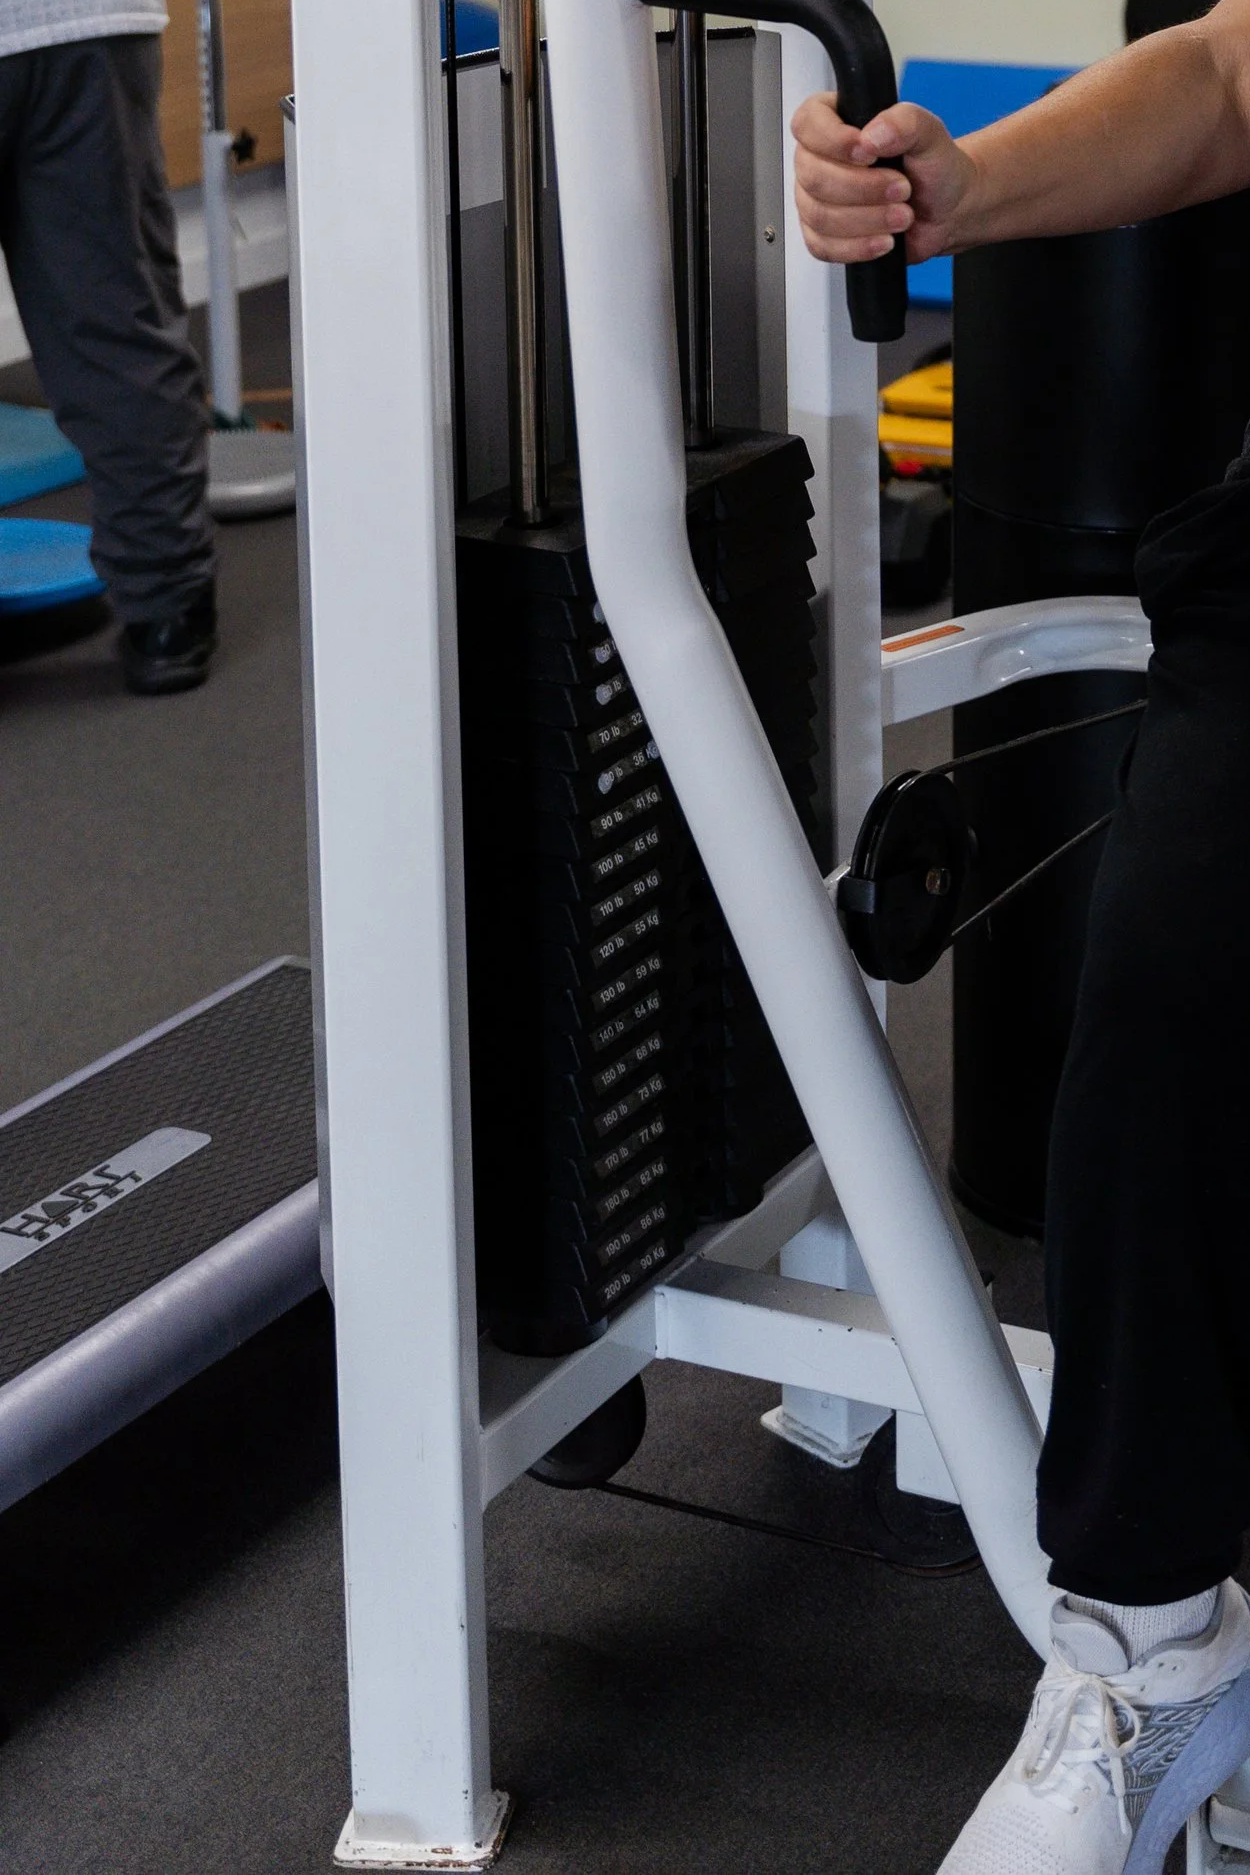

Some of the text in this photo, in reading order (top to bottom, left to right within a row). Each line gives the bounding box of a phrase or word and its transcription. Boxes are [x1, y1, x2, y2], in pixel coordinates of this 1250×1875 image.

[599, 712, 643, 743] 70 lb 32
[614, 766, 624, 779] lb
[632, 752, 644, 766] 36
[601, 792, 658, 829] 90 lb 41 Kg
[598, 831, 658, 874] 100 lb 45 Kg
[600, 874, 659, 916] 110 lb 50 Kg
[600, 914, 659, 958] 120 lb 55 Kg
[600, 958, 660, 1003] 130 lb 59 Kg
[599, 997, 659, 1043] 140 lb 64 Kg
[602, 1068, 616, 1085] 150
[616, 1063, 626, 1075] lb
[648, 1039, 660, 1052] Kg
[603, 1079, 662, 1127] 160 lb 73 Kg
[605, 1122, 663, 1169] 170 lb 77 Kg
[605, 1163, 664, 1212] 180 lb 82 Kg
[605, 1207, 665, 1256] 190 lb 86 Kg
[604, 1246, 665, 1299] 200 lb 90 Kg
